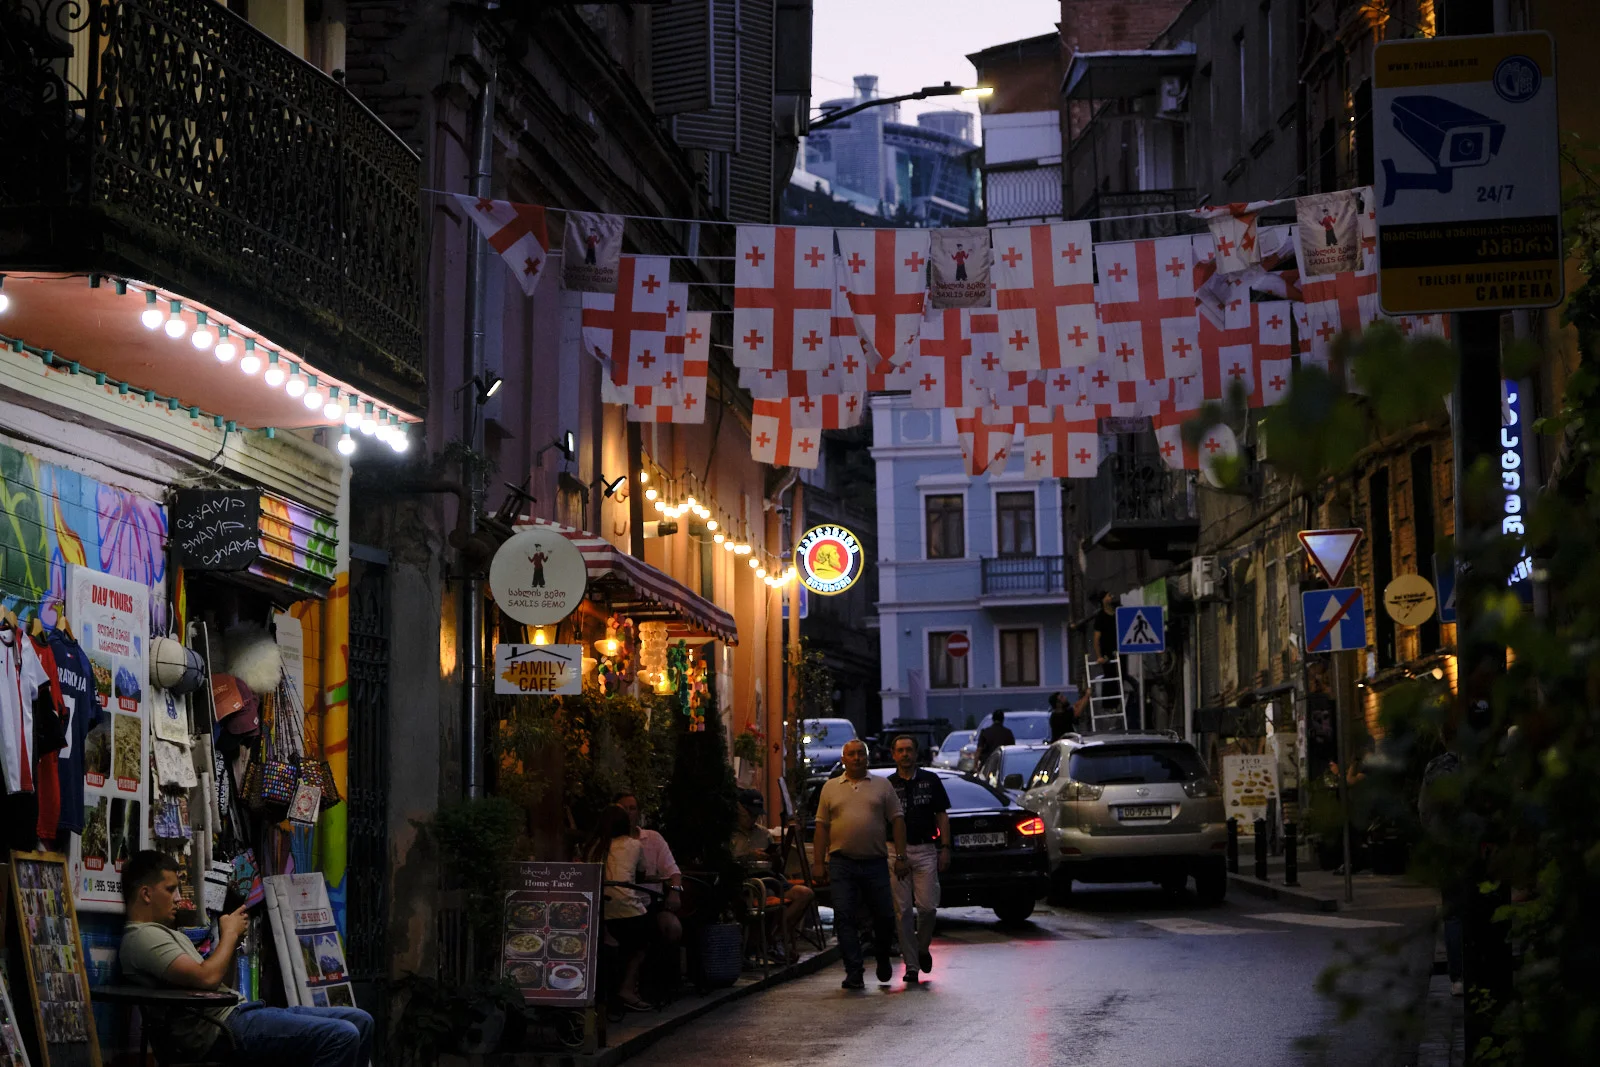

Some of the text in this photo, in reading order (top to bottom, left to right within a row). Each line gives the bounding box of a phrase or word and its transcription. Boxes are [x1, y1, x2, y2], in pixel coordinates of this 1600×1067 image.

[1477, 185, 1514, 203] 24/7
[1418, 269, 1553, 287] TBILISI MUNICIPALITY
[1476, 282, 1554, 301] CAMERA
[92, 584, 133, 614] DAY TOURS
[508, 588, 566, 600] სახლის გემო
[508, 599, 566, 609] SAXLIS GEMO
[511, 661, 566, 675] FAMILY
[525, 879, 574, 888] Home Taste
